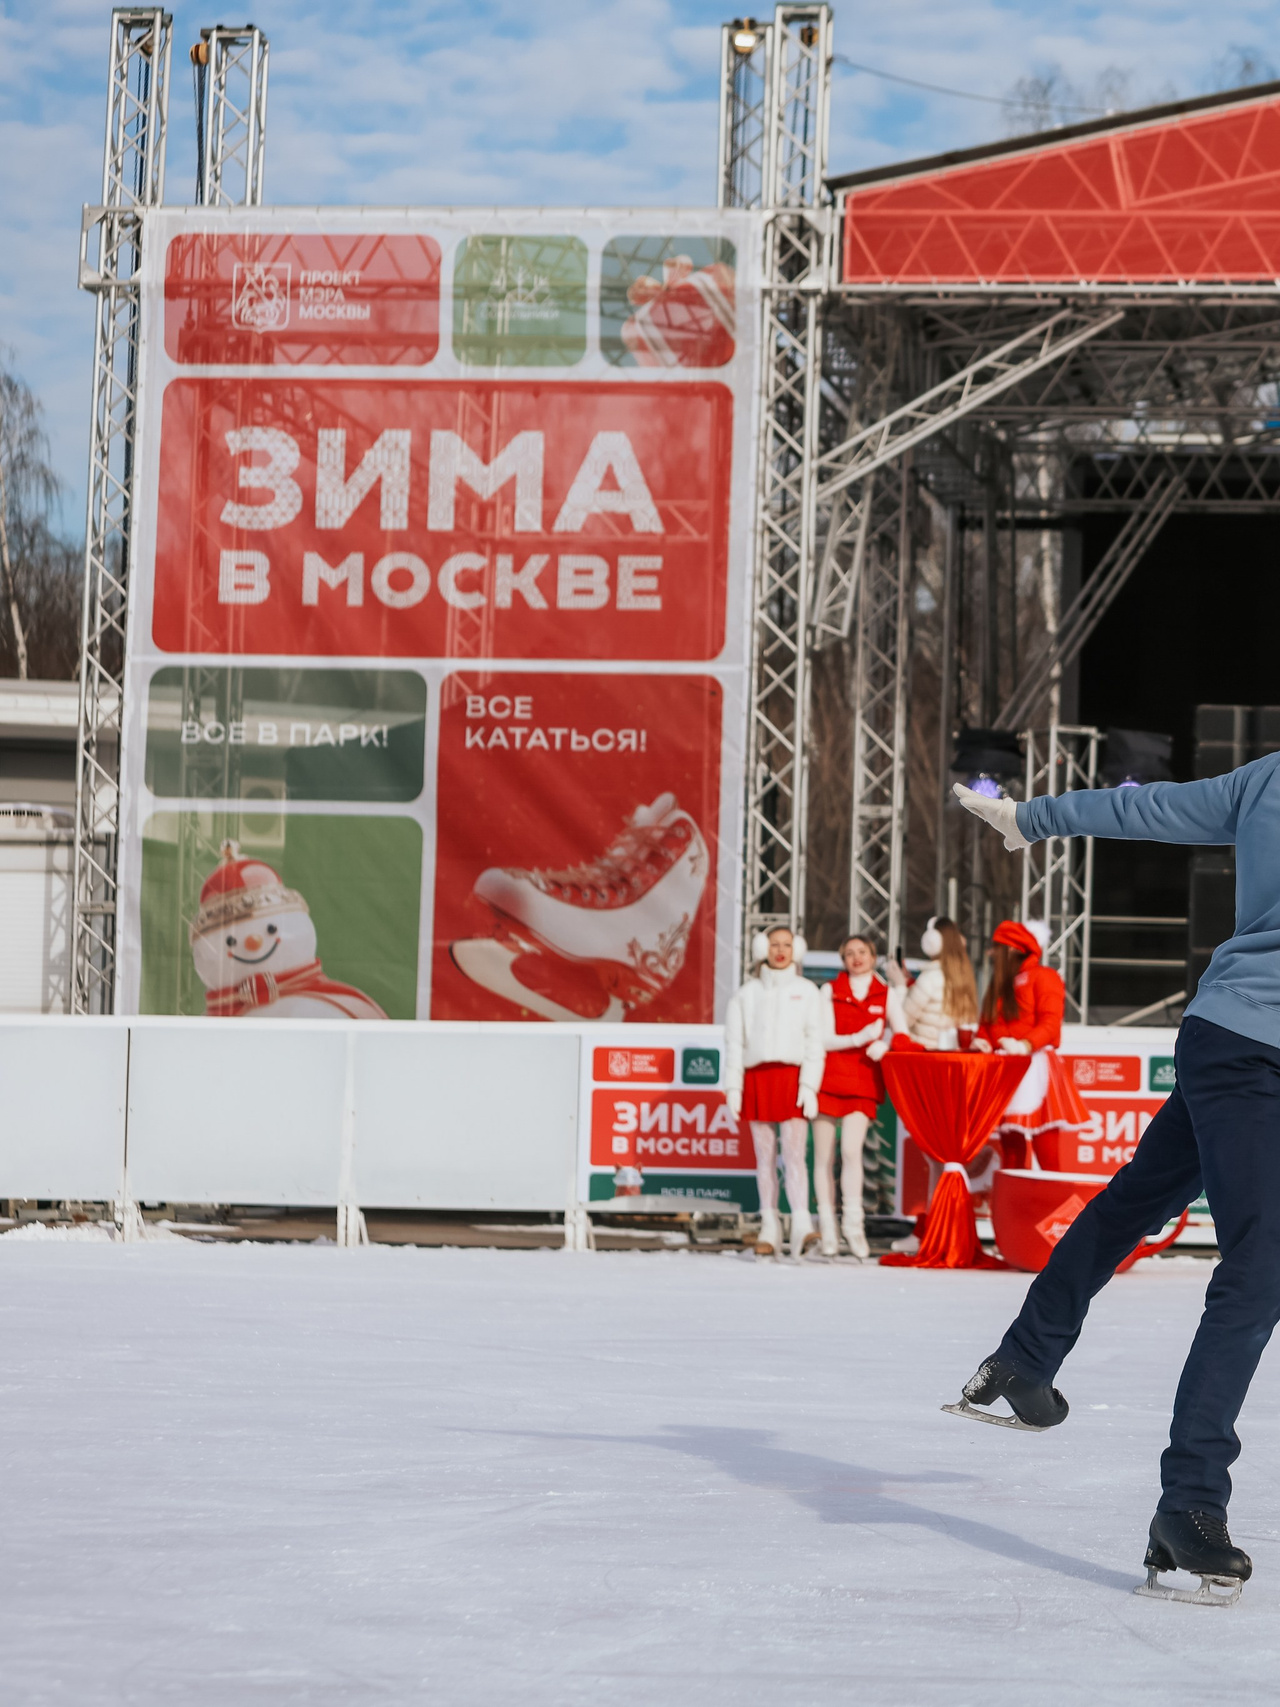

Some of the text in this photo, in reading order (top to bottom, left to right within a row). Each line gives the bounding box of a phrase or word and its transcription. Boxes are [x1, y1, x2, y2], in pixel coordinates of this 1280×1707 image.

[300, 269, 361, 286] ПРОЕКТ
[300, 286, 346, 303] МЭРА
[299, 303, 371, 320] МОСКВЫ
[218, 425, 665, 534] ЗИМА
[217, 549, 664, 611] В МОСКВЕ
[465, 695, 533, 720] ВСЕ
[180, 721, 389, 749] ВСЕ В ПАРК!
[464, 726, 648, 753] КАТАТЬСЯ!
[612, 1100, 740, 1135] ЗИМА
[611, 1136, 740, 1156] В МОСКВЕ
[1077, 1145, 1095, 1164] В
